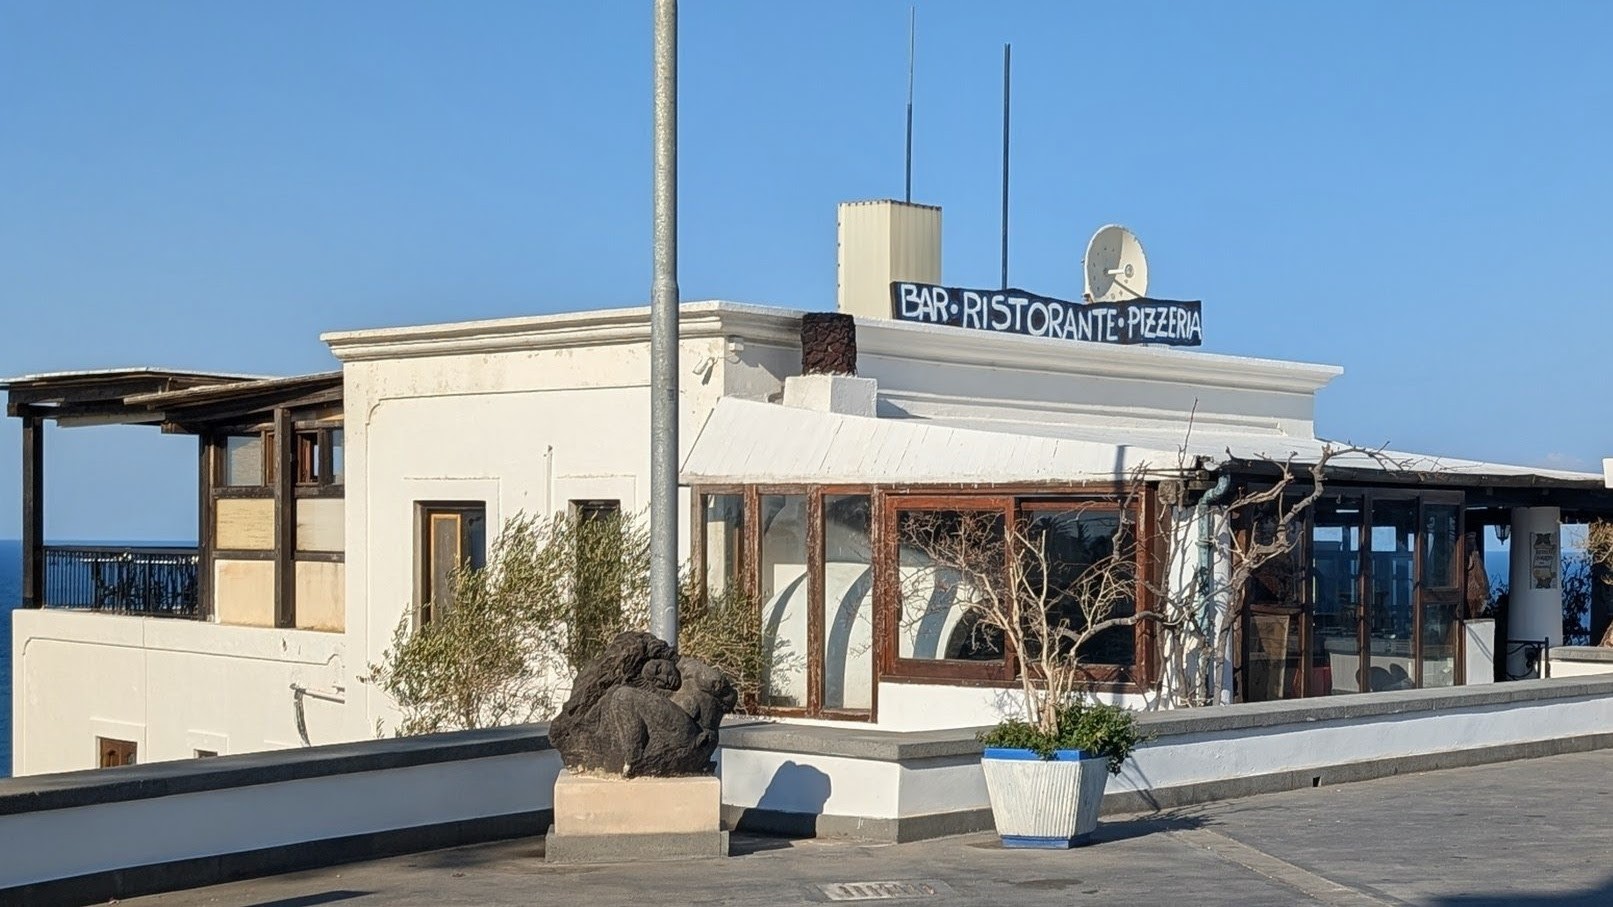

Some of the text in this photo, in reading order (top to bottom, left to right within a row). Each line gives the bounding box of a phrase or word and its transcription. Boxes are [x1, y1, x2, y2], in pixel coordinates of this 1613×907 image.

[900, 284, 1202, 341] BAR RISTORANTE PIZZERIA
